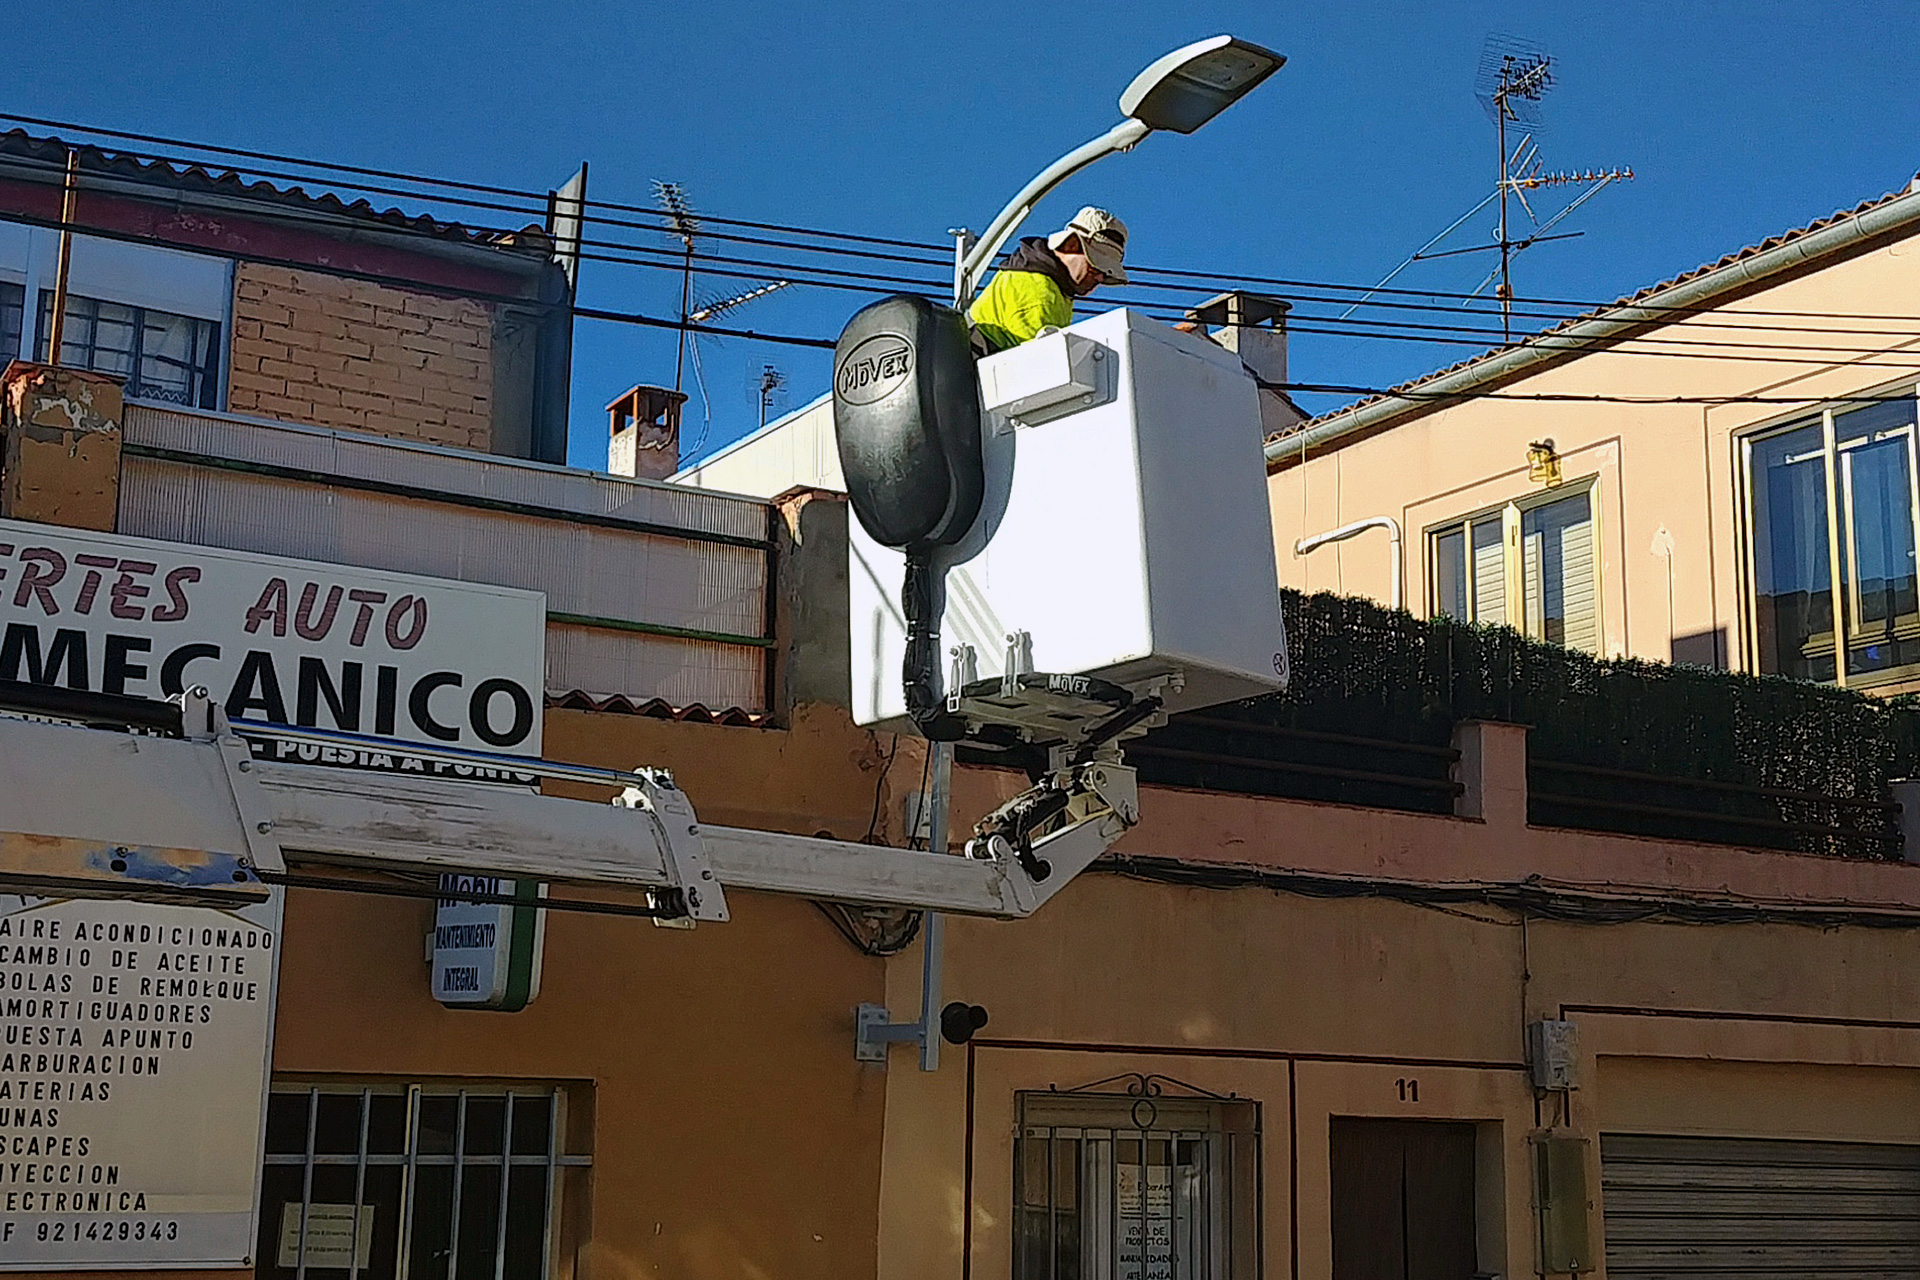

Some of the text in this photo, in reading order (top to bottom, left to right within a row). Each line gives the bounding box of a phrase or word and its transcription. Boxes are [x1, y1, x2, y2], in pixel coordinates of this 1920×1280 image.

[244, 577, 428, 650] AUTO
[0, 623, 534, 748] MECANICO
[1049, 675, 1090, 694] MOVEX
[0, 919, 272, 950] AIRE ACONDICIONADO
[436, 923, 495, 950] MANTENIMIENTO
[0, 946, 245, 975] CAMBIO DE ACEITE
[93, 976, 118, 994] DE
[443, 966, 479, 991] INTEGRAL
[0, 998, 211, 1024] MORTIGUADORES
[0, 1025, 193, 1049] UESTA APUNTO
[2, 1053, 159, 1075] ARBURACION
[0, 1081, 110, 1101] ATERIAS
[1395, 1079, 1419, 1102] 11
[0, 1108, 59, 1127] UNAS
[0, 1163, 118, 1185] YECCION
[6, 1192, 147, 1212] ECTRONICA
[37, 1221, 178, 1242] 921429343
